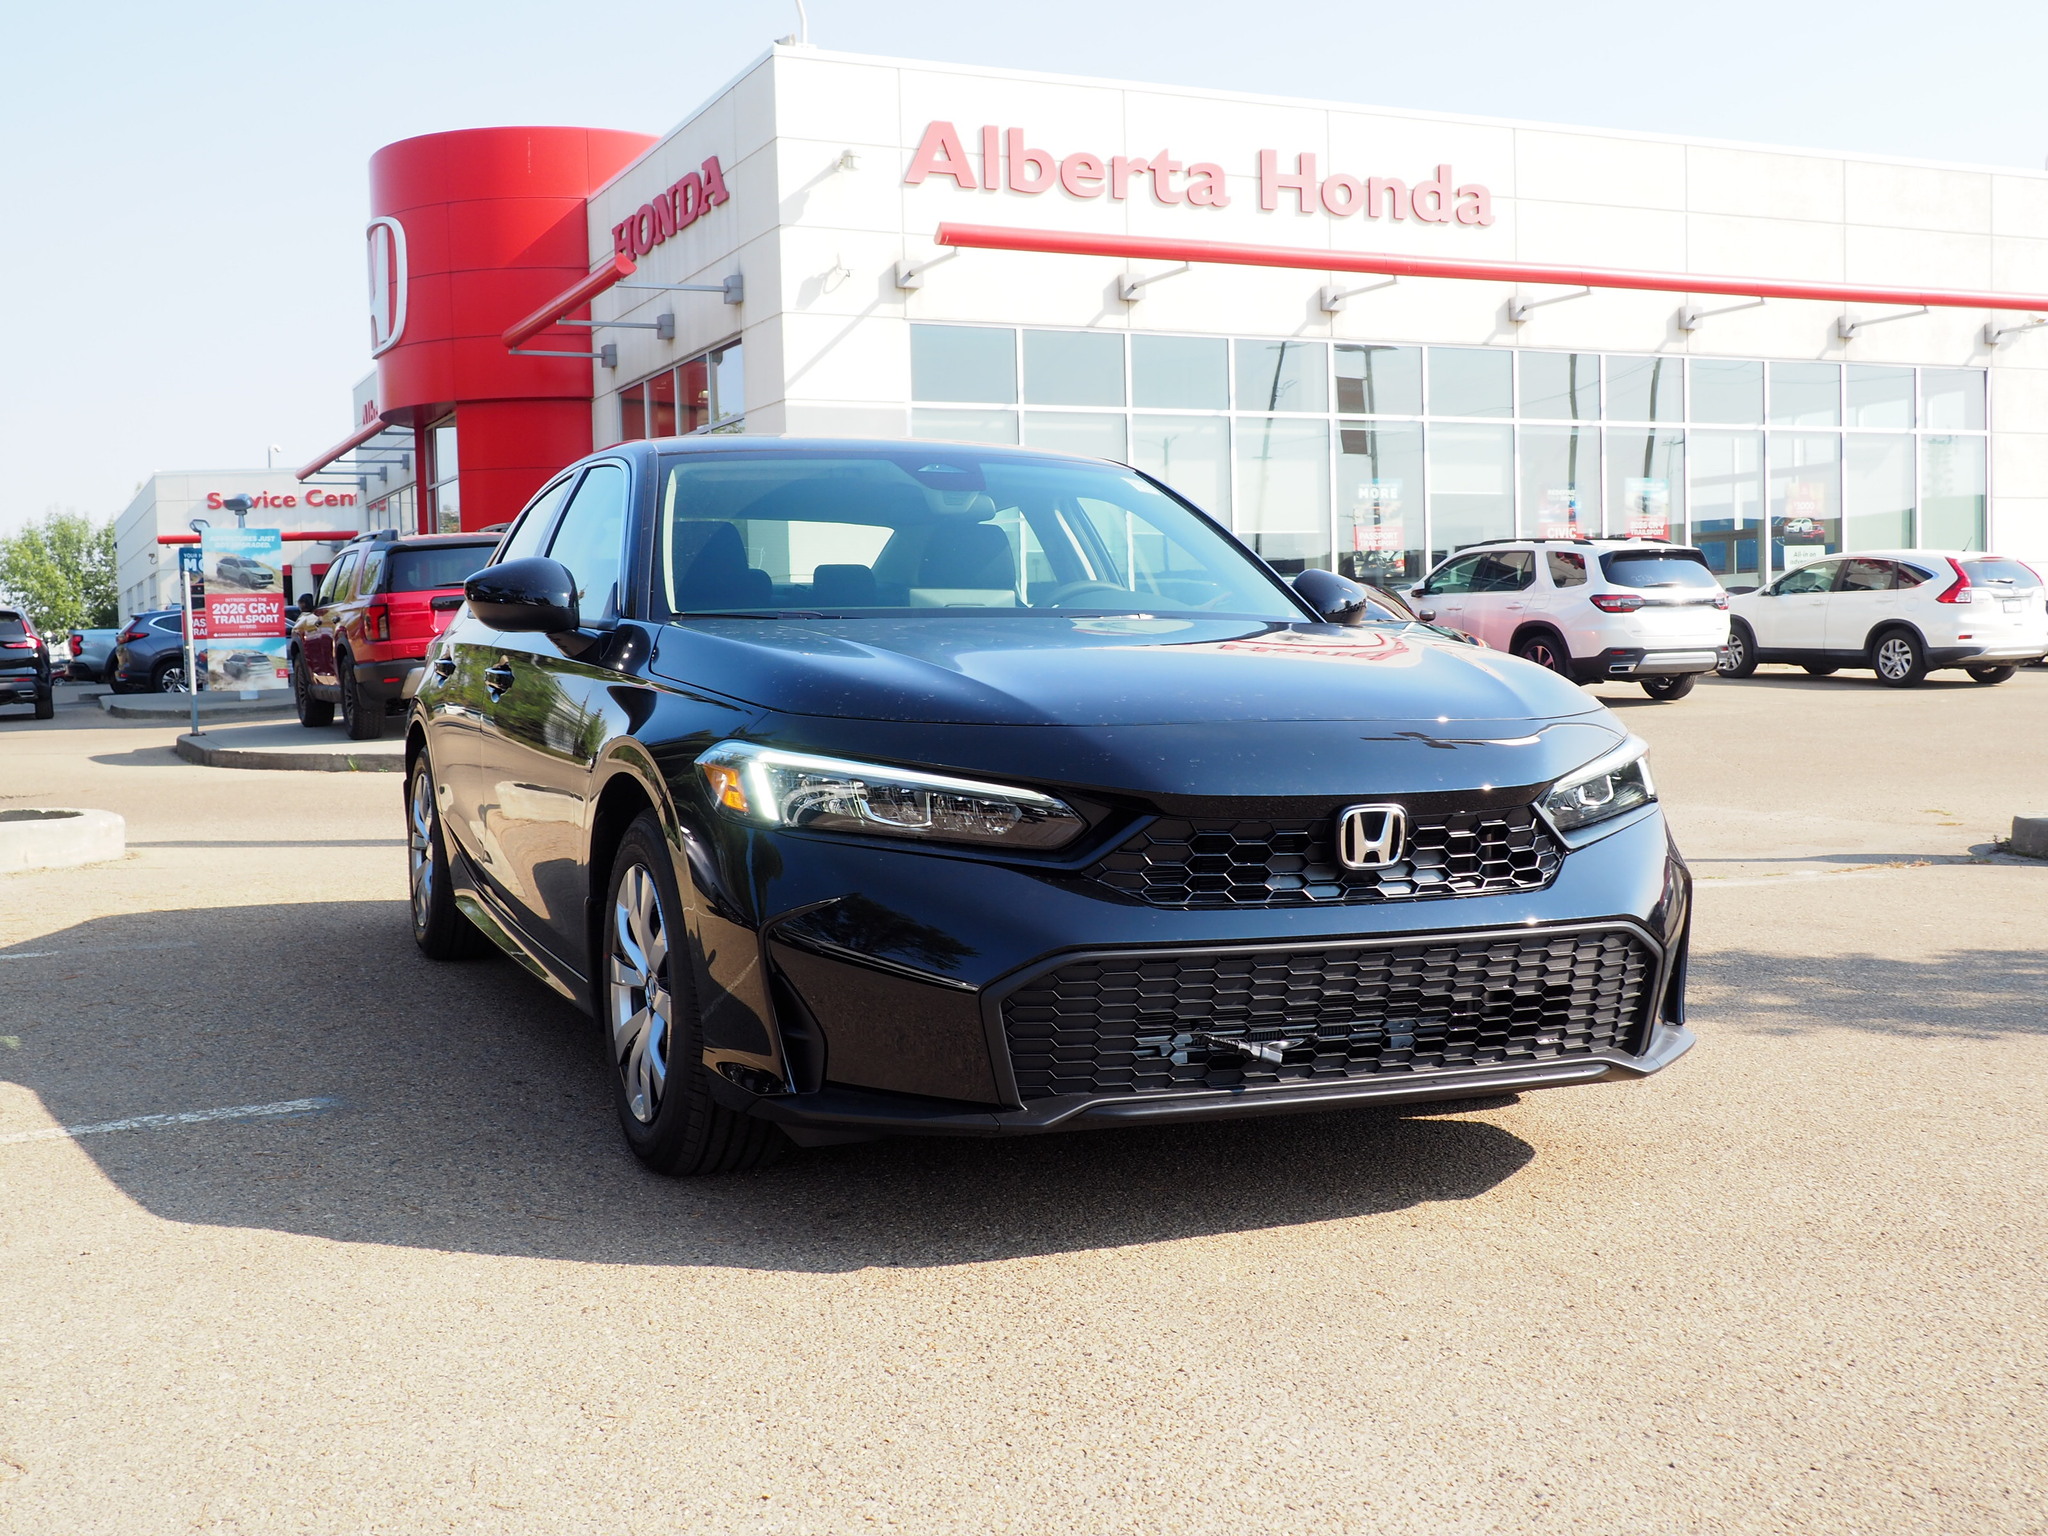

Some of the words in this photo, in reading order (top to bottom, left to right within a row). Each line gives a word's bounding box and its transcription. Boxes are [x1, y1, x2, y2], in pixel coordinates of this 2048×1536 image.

[903, 119, 1230, 208] Alberta
[1255, 148, 1495, 227] Honda
[611, 155, 730, 262] HONDA
[1358, 487, 1398, 499] MORE
[206, 490, 297, 510] Svice
[1547, 527, 1577, 539] CIVIC
[212, 603, 246, 615] 2026
[248, 602, 279, 614] CR-V
[212, 614, 280, 625] TRAILSPORT
